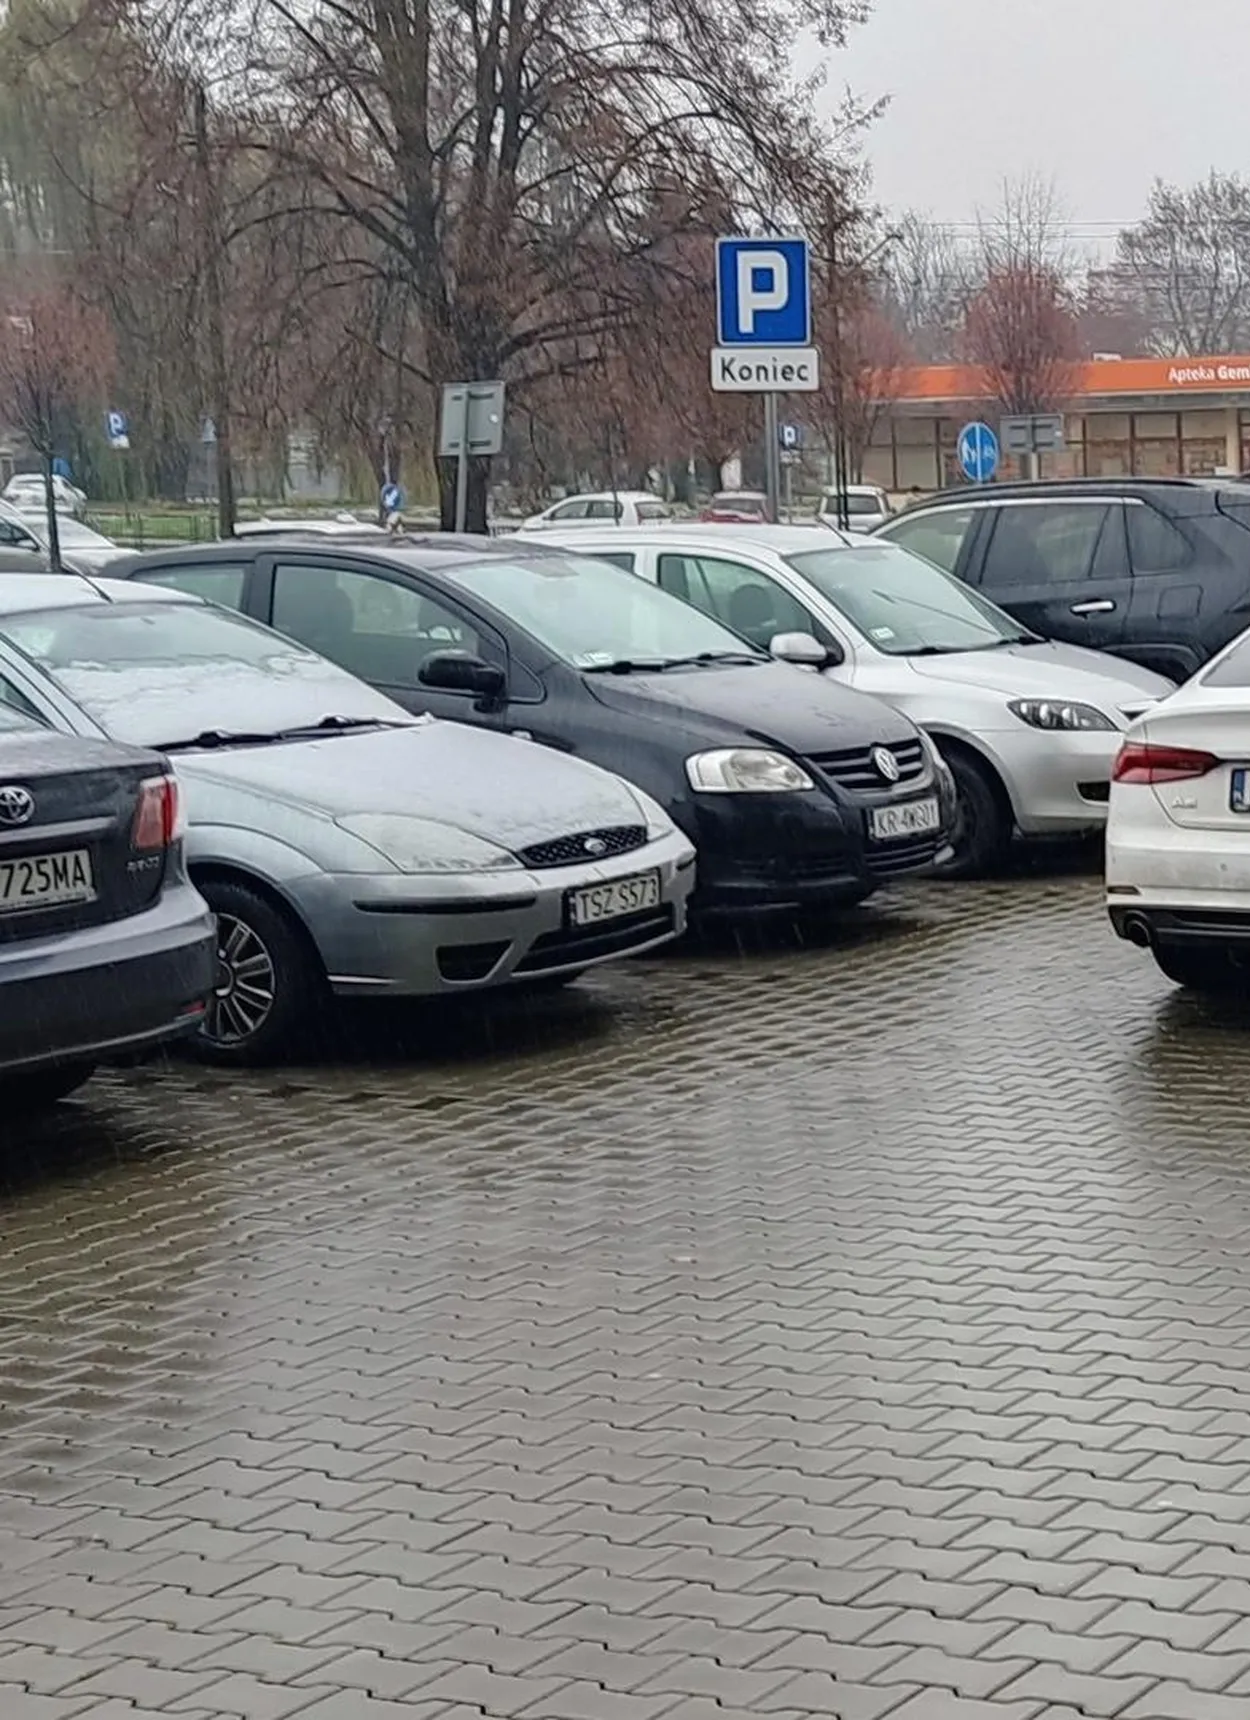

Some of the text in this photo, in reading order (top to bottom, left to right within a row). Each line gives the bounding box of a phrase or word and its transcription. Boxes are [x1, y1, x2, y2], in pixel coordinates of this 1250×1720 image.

[736, 250, 788, 334] P
[720, 356, 809, 383] Koniec
[1168, 365, 1215, 385] Apteka
[109, 413, 122, 435] P
[784, 426, 796, 446] P
[877, 809, 898, 834] KR
[0, 853, 87, 898] 725MA
[579, 878, 657, 920] TSZ S573
